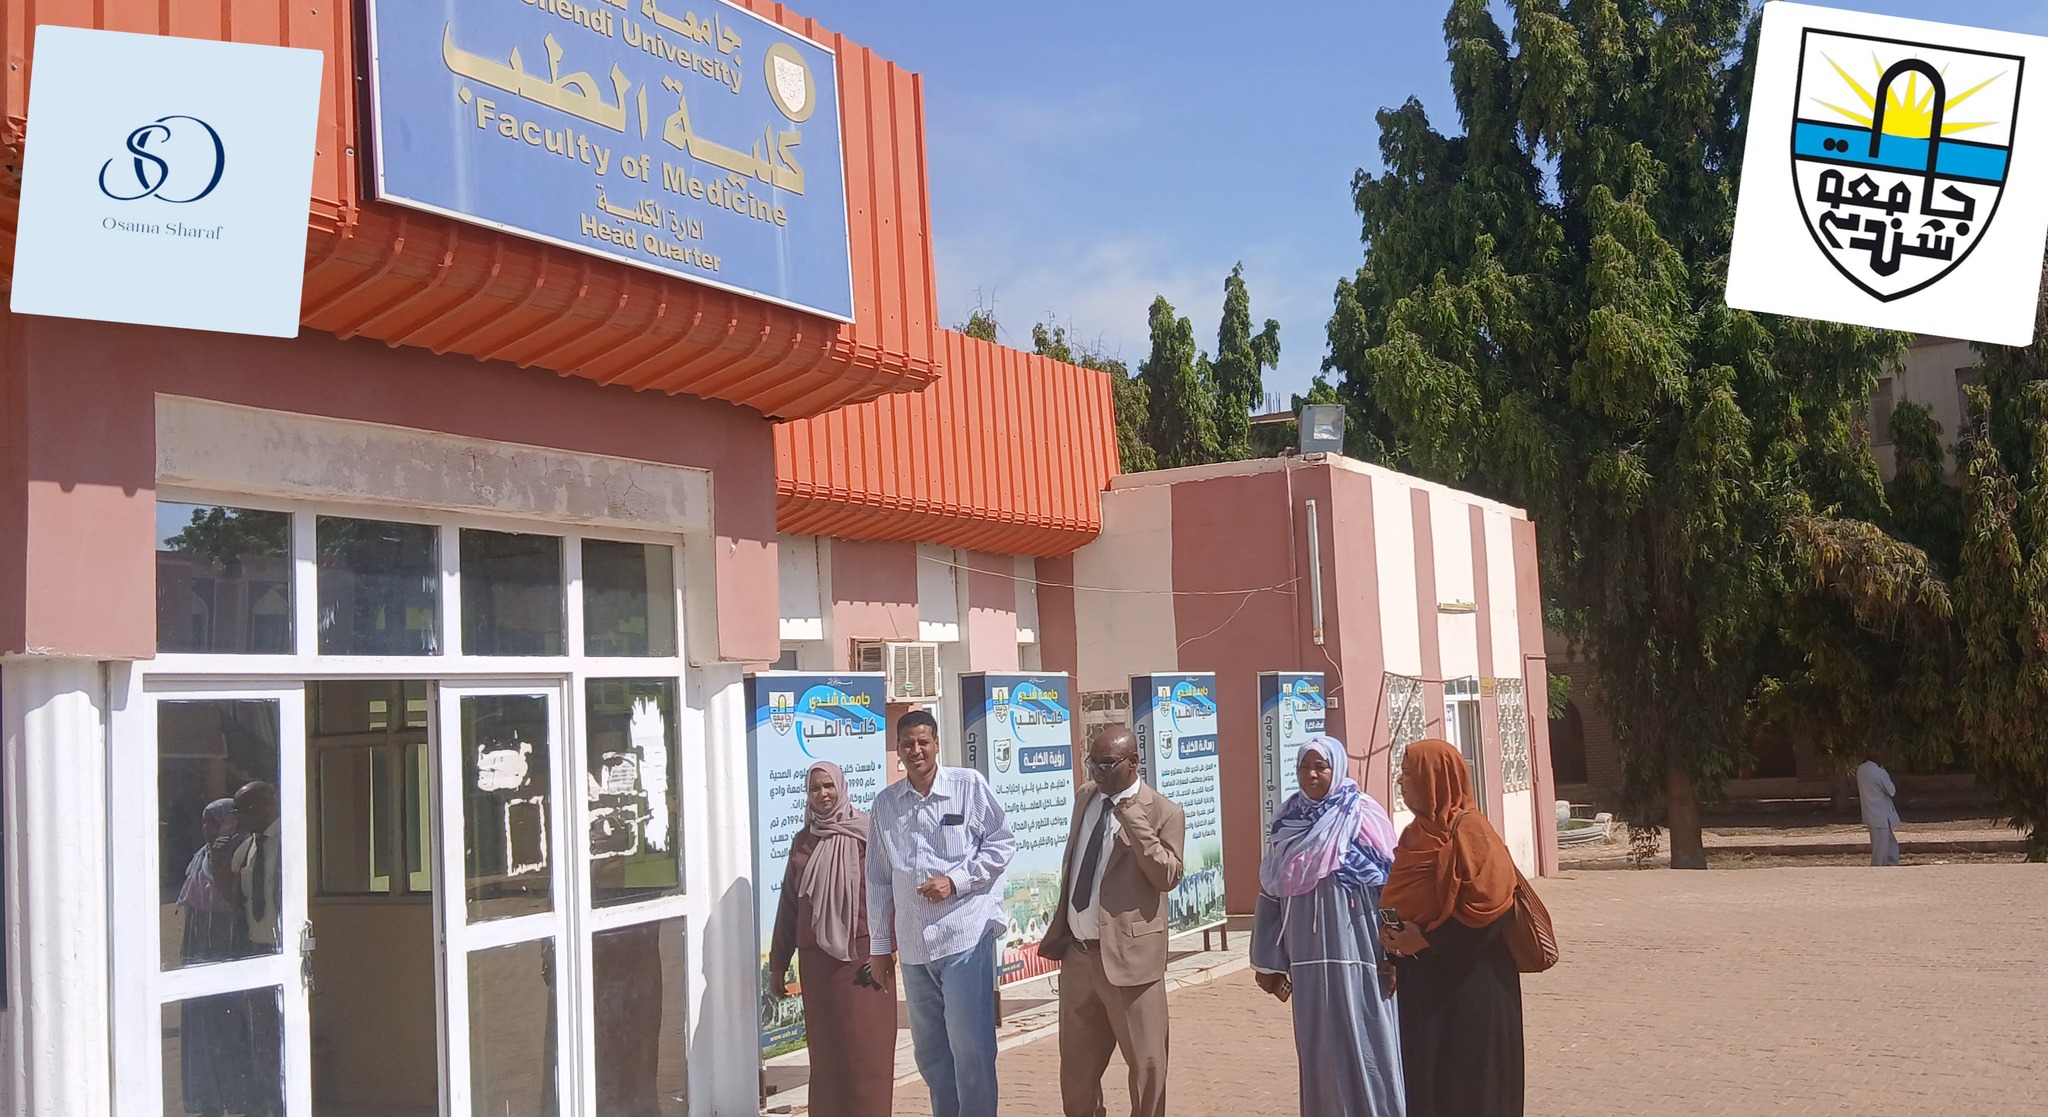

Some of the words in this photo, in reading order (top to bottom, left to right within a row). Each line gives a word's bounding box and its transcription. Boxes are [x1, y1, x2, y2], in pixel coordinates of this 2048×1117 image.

[621, 17, 743, 94] University
[441, 20, 648, 142] الطب
[662, 75, 804, 196] كلية
[476, 96, 611, 176] Faculty
[621, 154, 650, 184] of
[661, 160, 788, 229] Medicine
[596, 183, 666, 229] الكلية
[580, 212, 638, 250] Head
[643, 233, 720, 271] Quarter
[809, 691, 838, 712] شندي
[840, 692, 871, 708] جامعة
[1018, 689, 1038, 704] شندي
[1038, 689, 1059, 701] جامعة
[845, 718, 877, 740] كلية
[1014, 711, 1040, 729] الطب
[1041, 710, 1063, 728] كلية
[803, 719, 842, 742] الطب
[1023, 752, 1048, 769] الكلية
[1049, 750, 1065, 767] رؤية
[865, 777, 876, 788] عام
